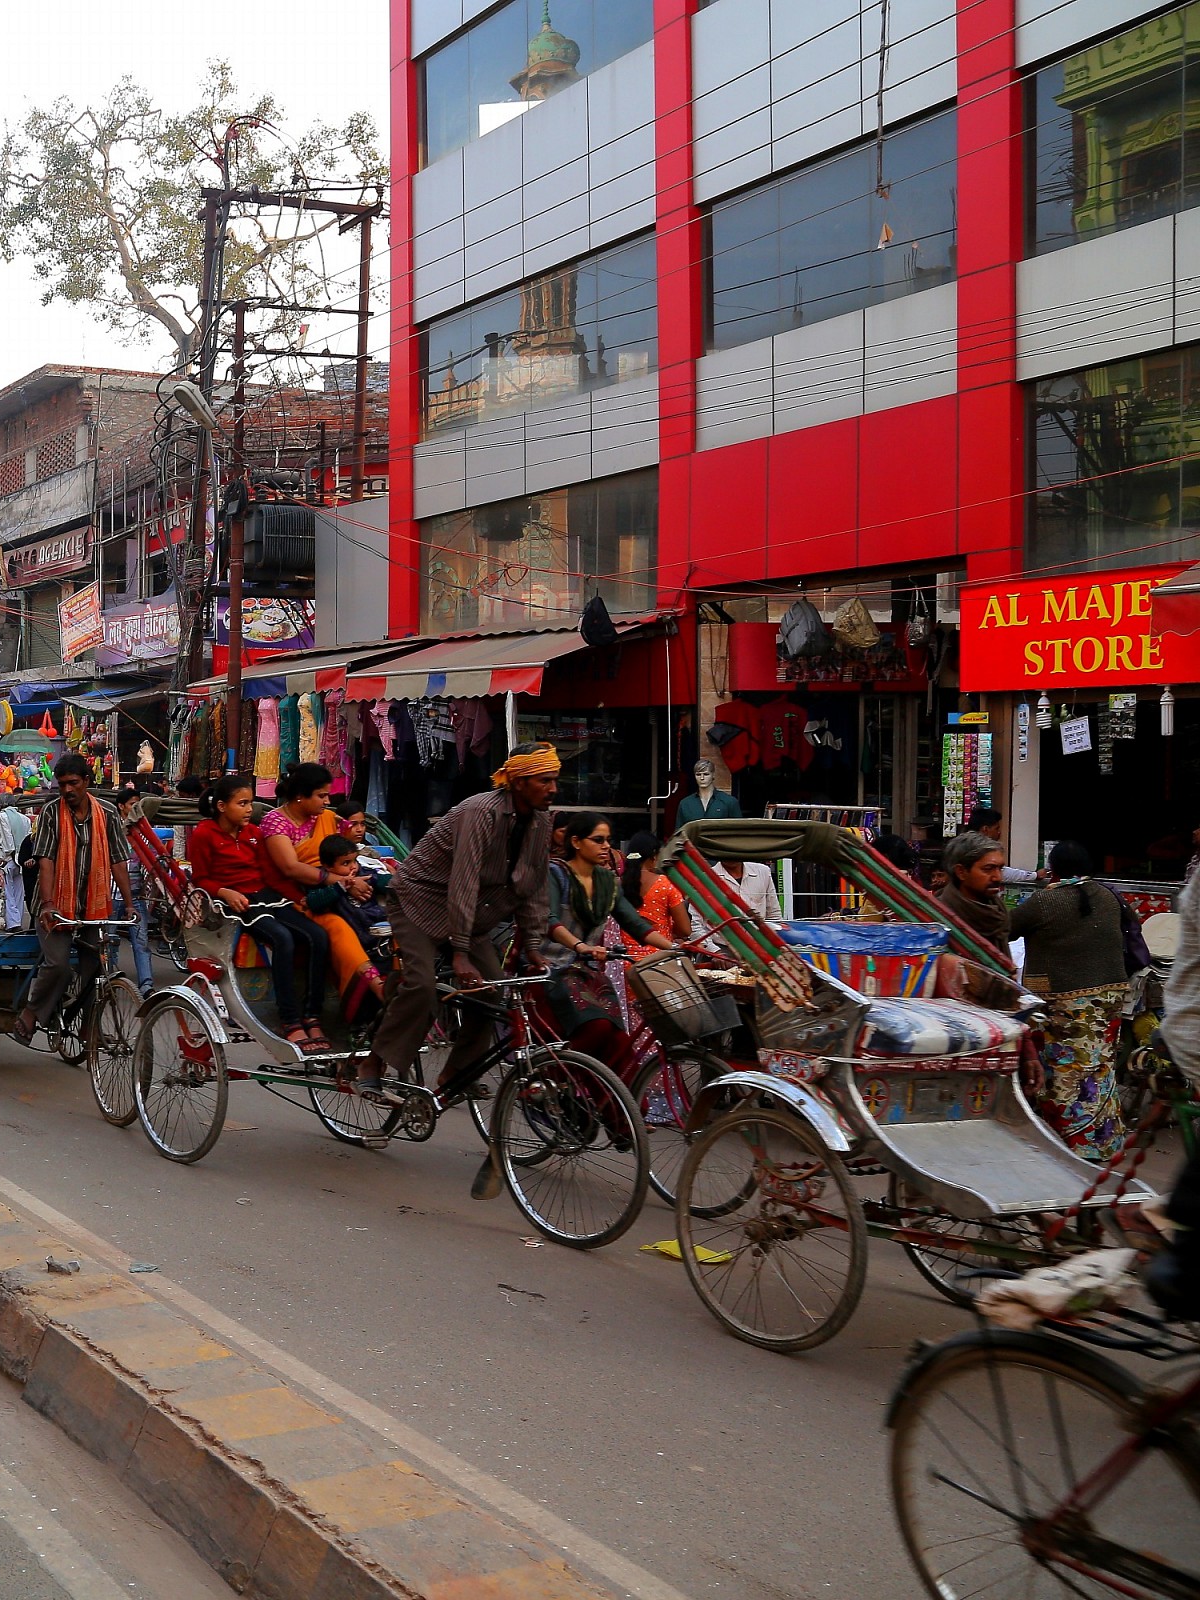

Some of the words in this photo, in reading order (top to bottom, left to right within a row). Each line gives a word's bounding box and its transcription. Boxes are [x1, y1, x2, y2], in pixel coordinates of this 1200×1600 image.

[144, 603, 167, 638] होटल
[978, 593, 1029, 629] AL
[1024, 634, 1165, 676] STORE
